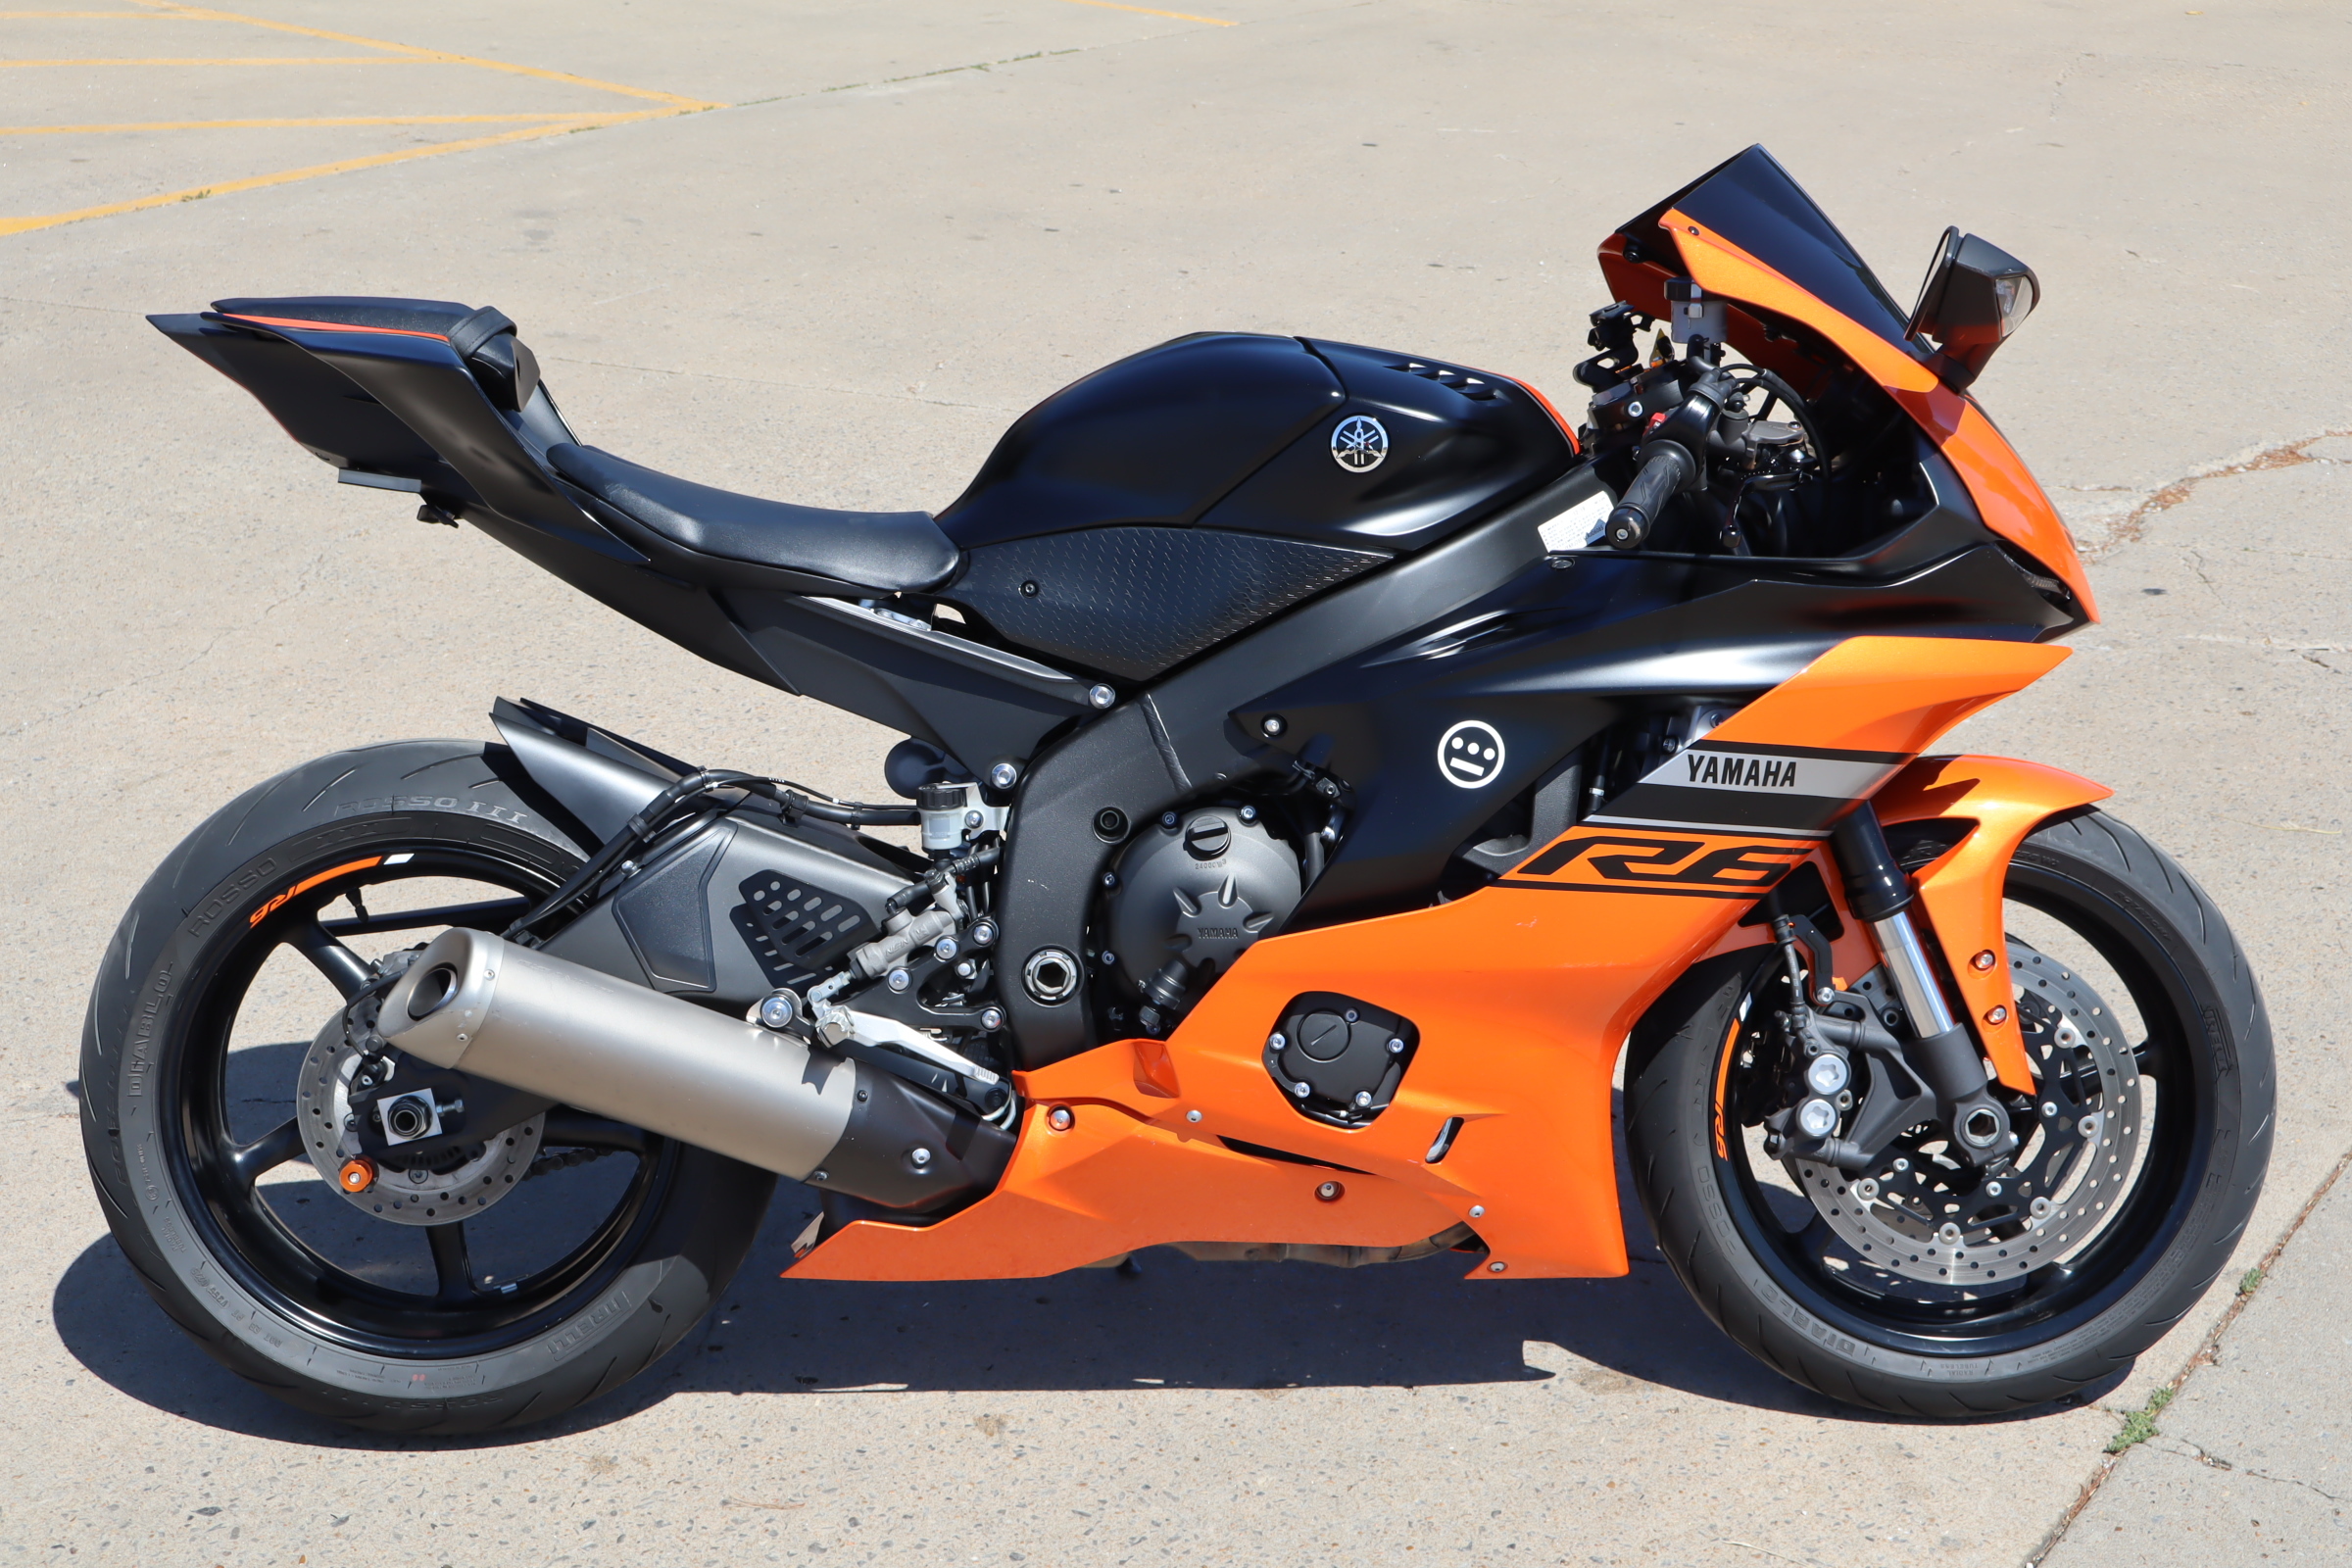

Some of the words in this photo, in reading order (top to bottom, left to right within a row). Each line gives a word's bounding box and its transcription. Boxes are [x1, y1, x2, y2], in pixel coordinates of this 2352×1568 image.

[1687, 753, 1797, 788] YAMAHA
[333, 794, 460, 818] ROSSO
[1516, 836, 1814, 889] R6
[249, 885, 298, 929] R6
[1198, 927, 1240, 940] YAMAHA
[125, 968, 172, 1098] DIABLO
[186, 857, 278, 938] ROSSO
[1713, 1102, 1730, 1162] R6
[547, 1290, 632, 1361] PIRELLI
[1761, 1283, 1856, 1358] DIABLO
